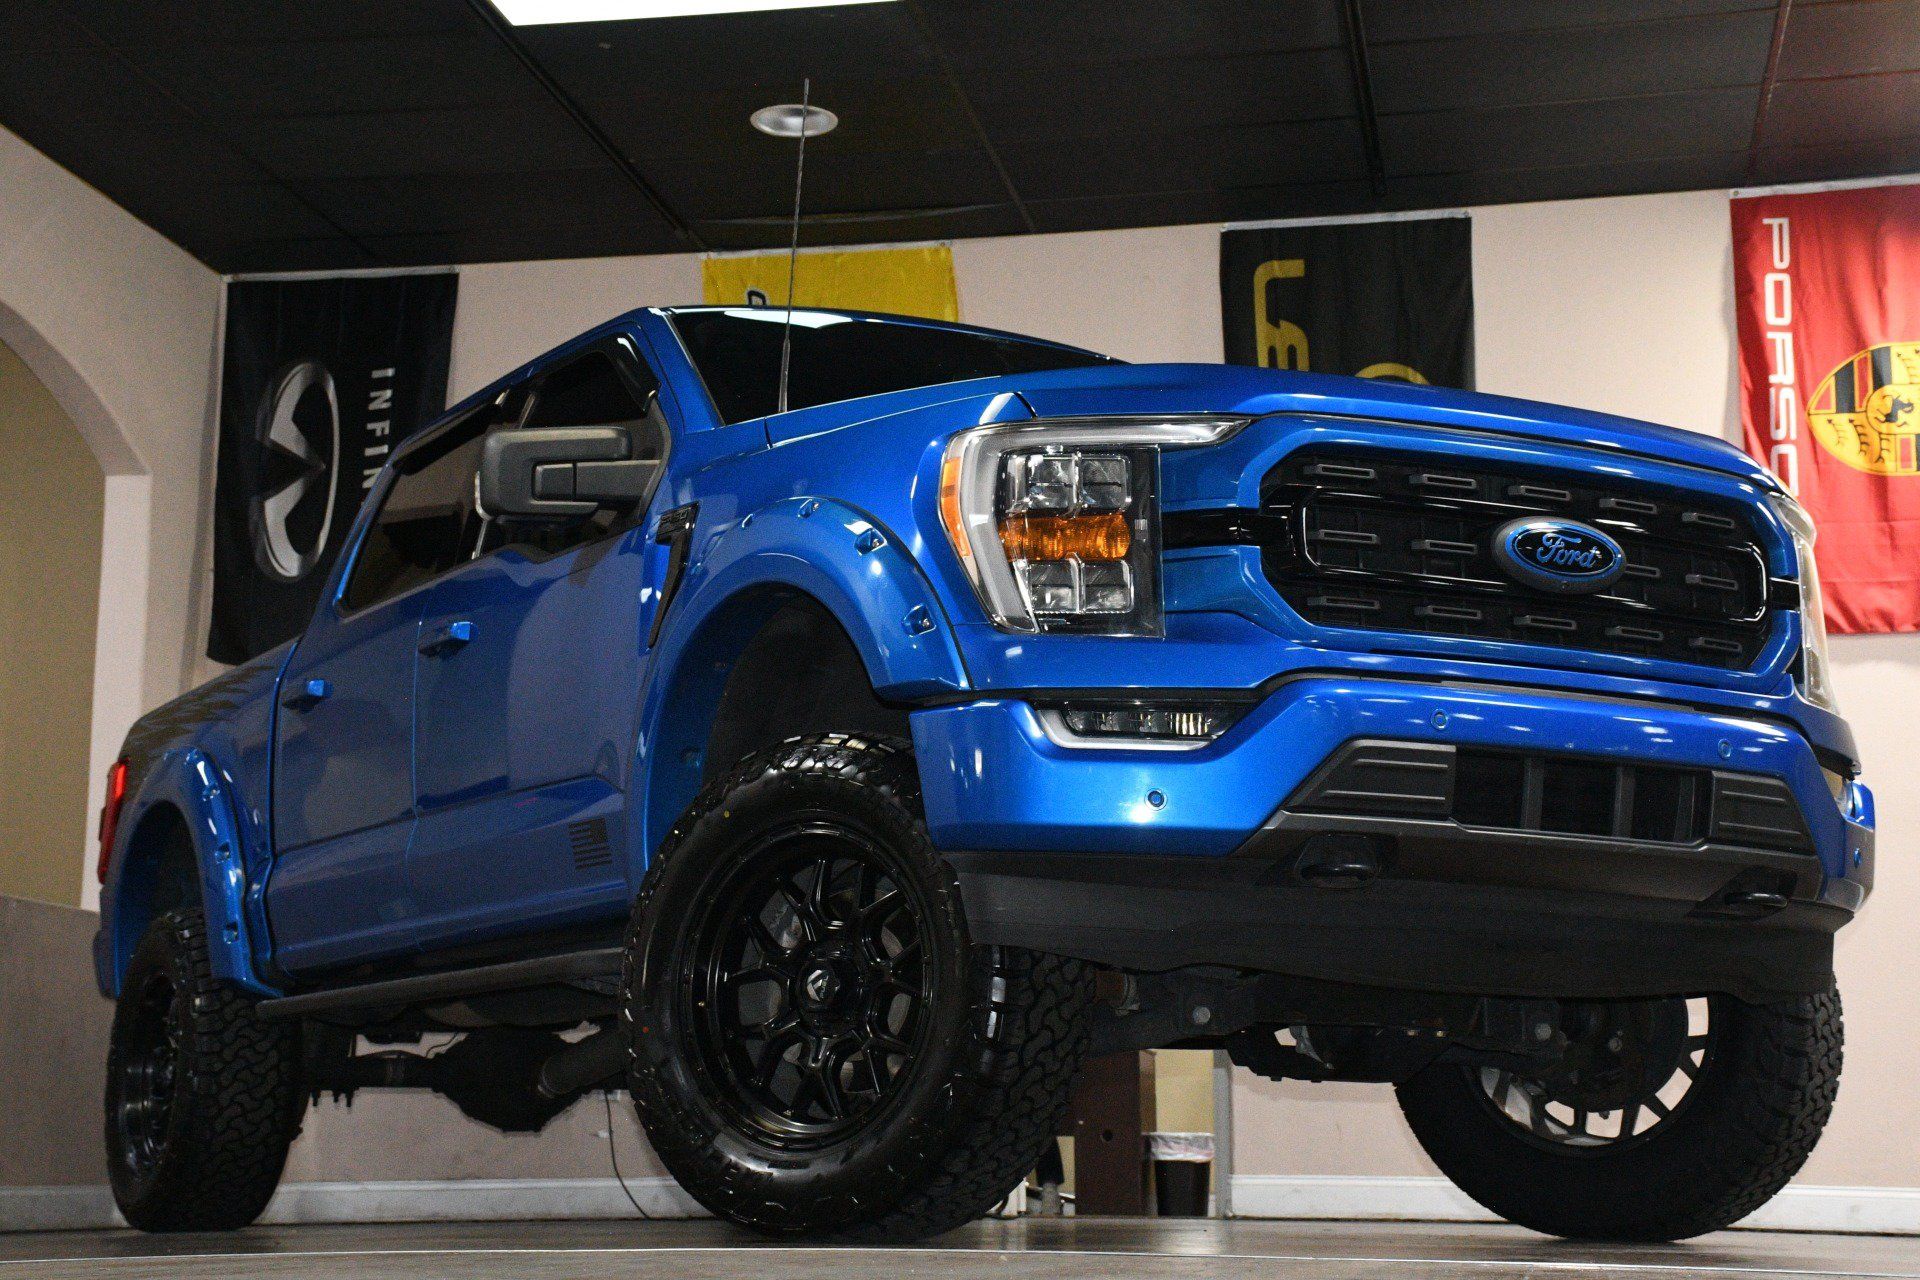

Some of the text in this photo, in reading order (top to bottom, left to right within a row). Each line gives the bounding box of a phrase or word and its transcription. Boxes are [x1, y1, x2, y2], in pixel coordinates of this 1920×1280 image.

[1762, 217, 1800, 497] PORSC
[361, 367, 396, 490] INFIN
[1536, 532, 1602, 569] Ford
